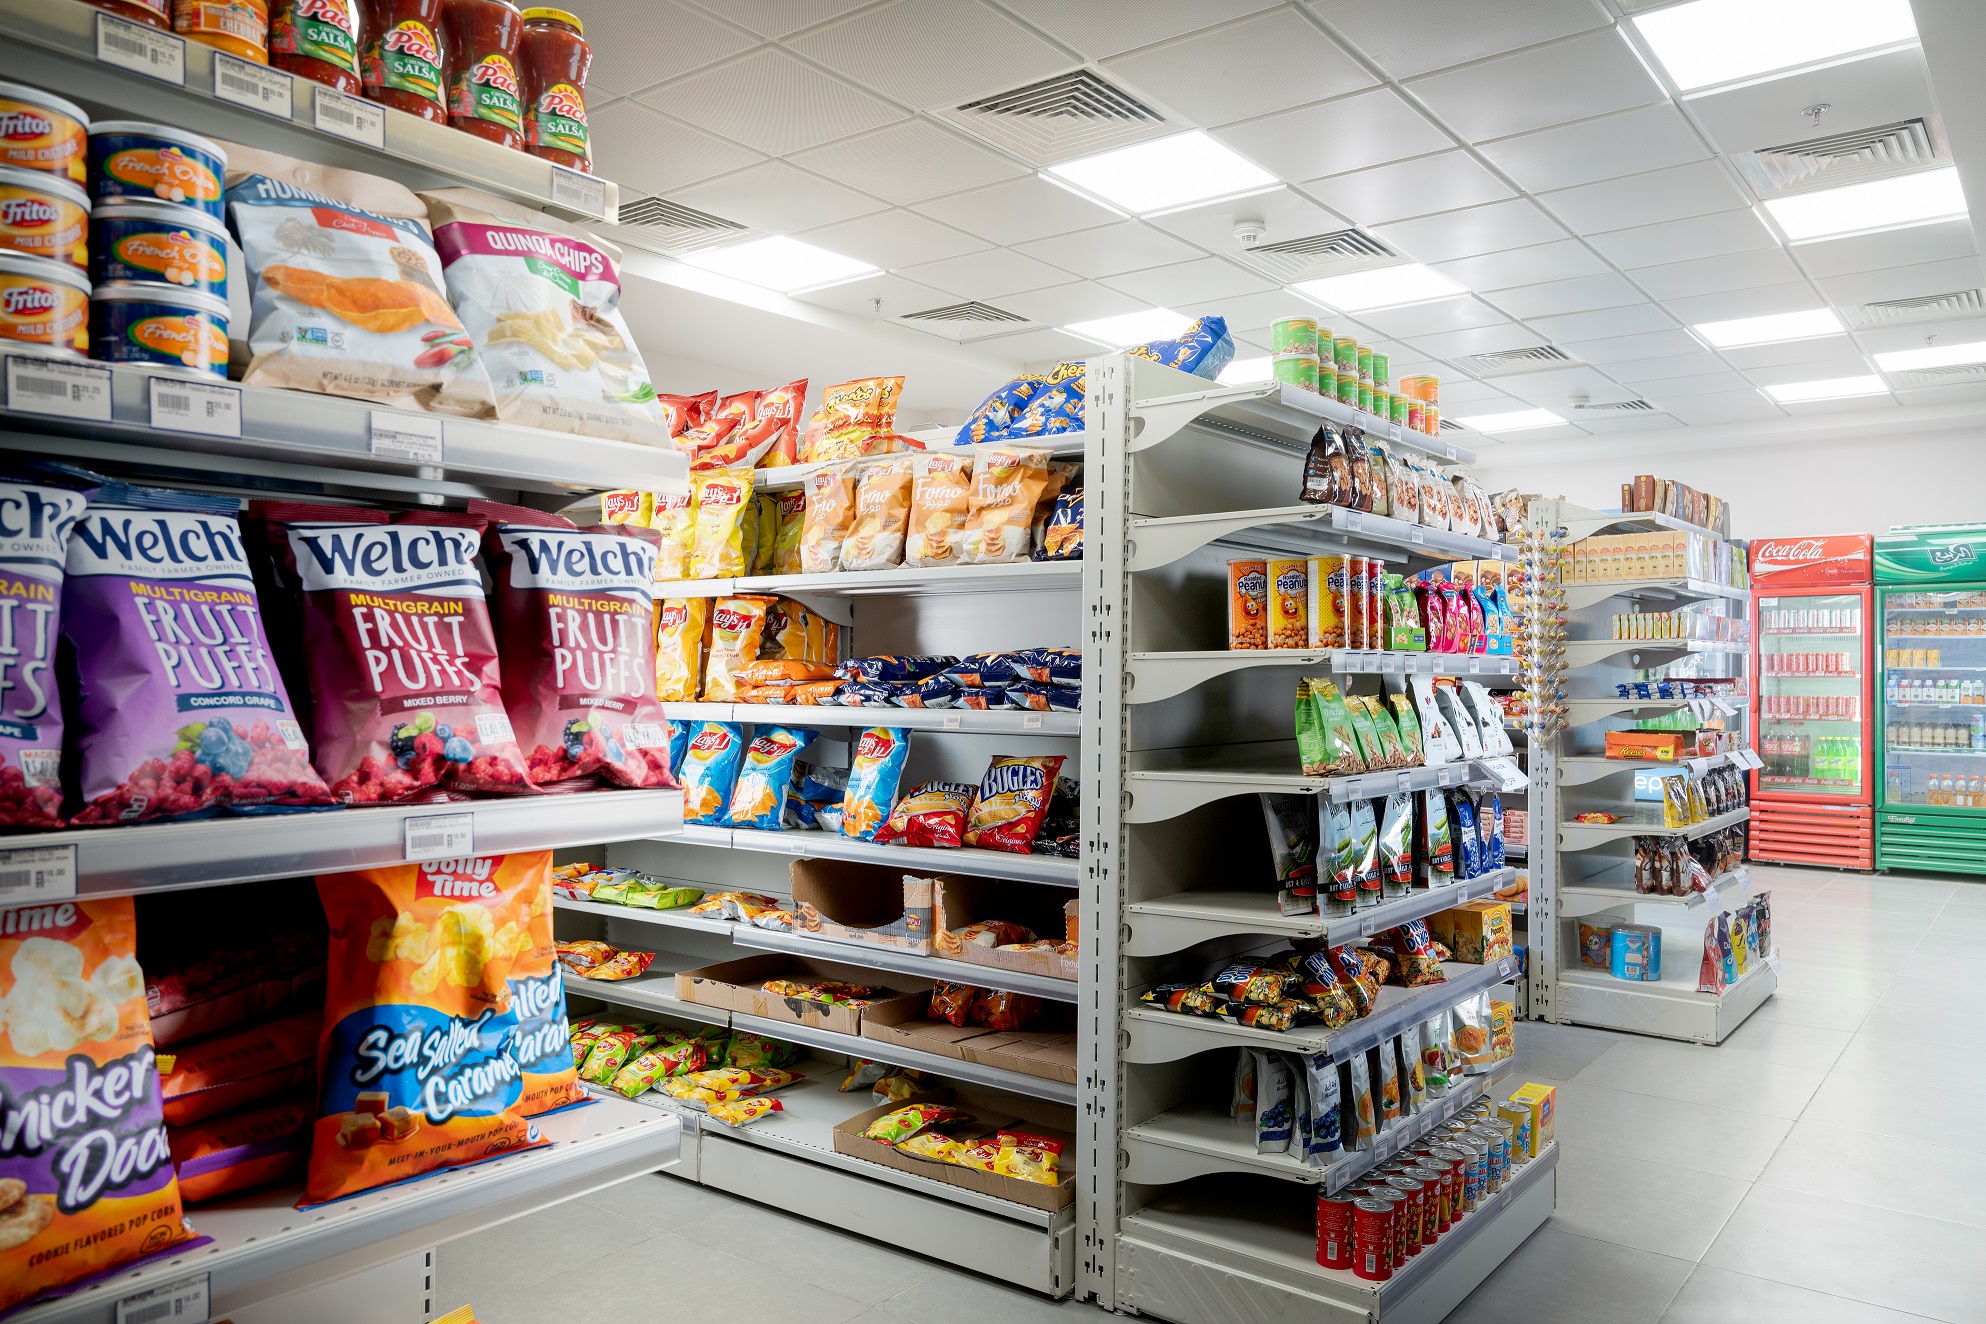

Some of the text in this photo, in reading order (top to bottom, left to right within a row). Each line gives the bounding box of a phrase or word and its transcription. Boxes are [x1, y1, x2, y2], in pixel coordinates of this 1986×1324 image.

[546, 9, 577, 22] MEDIUM
[308, 28, 351, 51] SALSA
[319, 25, 345, 38] CHUNKY
[394, 61, 437, 83] SALSA
[405, 58, 430, 70] CHUNKY
[481, 94, 518, 115] SALSA
[491, 90, 513, 101] CHUNKY
[0, 113, 52, 138] Fritos
[548, 122, 584, 139] SALSA
[557, 118, 579, 127] CHUNKY
[117, 156, 169, 175] French
[1, 200, 58, 225] Fritos
[126, 240, 179, 259] French
[486, 231, 604, 274] QUINOA CHIPS
[3, 287, 60, 313] Fritos
[142, 324, 195, 343] French
[1047, 362, 1086, 385] Chee
[916, 478, 964, 500] Forno
[73, 517, 244, 564] Welch'
[1758, 539, 1828, 561] Coca-Cola
[120, 564, 243, 575] FAMILY FARMER OWNED
[343, 569, 465, 588] FAMILY FARMER OWNED
[129, 581, 253, 605] MULTIGRAIN
[546, 578, 575, 586] FAMILY
[580, 578, 614, 586] FARMER
[1238, 581, 1267, 591] Peanut
[1277, 579, 1307, 590] Peanut
[350, 593, 463, 614] MULTIGRAIN
[548, 594, 645, 616] MULTIGRAIN
[134, 597, 262, 649] FRUIT
[352, 607, 465, 657] FRUIT
[549, 607, 645, 657] FRUIT
[154, 640, 277, 693] PUFFS
[365, 648, 482, 692] PUFFS
[554, 648, 646, 698] PUFFS
[190, 696, 276, 709] CONCORD GRAPE
[403, 695, 468, 708] MIXED BERRY
[580, 697, 625, 710] MIXED BERRY
[1620, 746, 1647, 756] Reese's
[983, 764, 1044, 799] BUGLES
[427, 874, 497, 898] Time
[1399, 918, 1426, 936] DING
[1491, 925, 1505, 936] Popcorn
[355, 1009, 493, 1083] Sea Salted
[0, 1048, 155, 1151] nicker
[388, 1127, 503, 1167] MELT-IN-YOUR-MOUTH POP
[29, 1203, 175, 1267] COOKIE FLAVORED POP CORN
